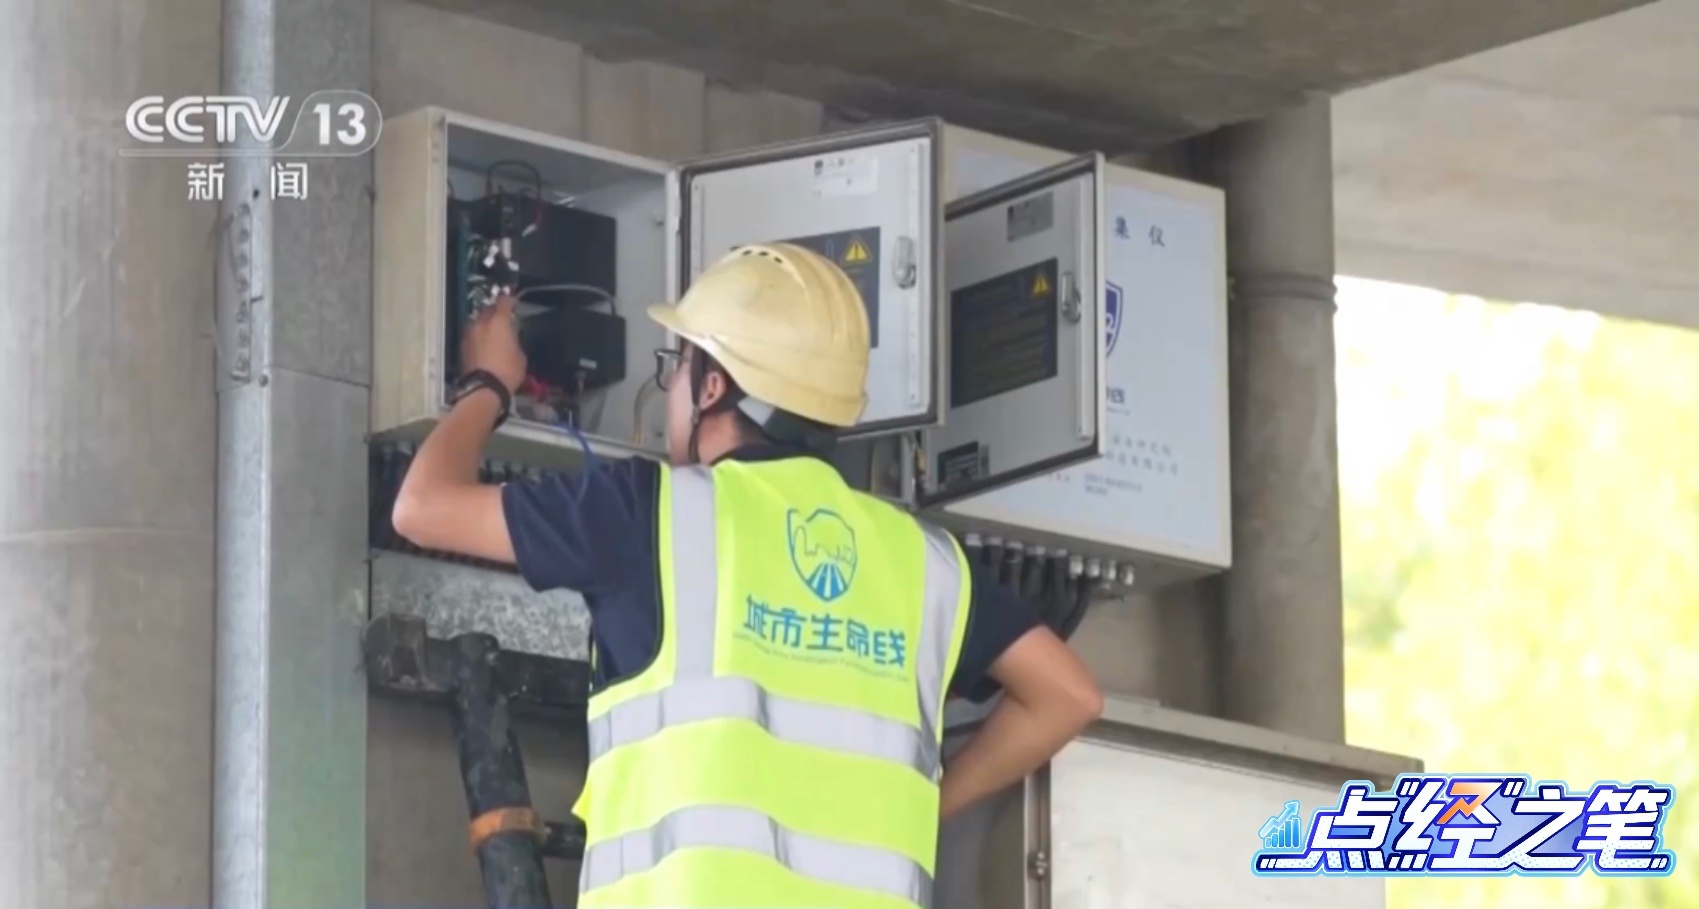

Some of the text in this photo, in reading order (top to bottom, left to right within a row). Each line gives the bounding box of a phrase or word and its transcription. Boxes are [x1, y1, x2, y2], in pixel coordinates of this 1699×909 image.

[743, 593, 906, 669] 城市生命线
